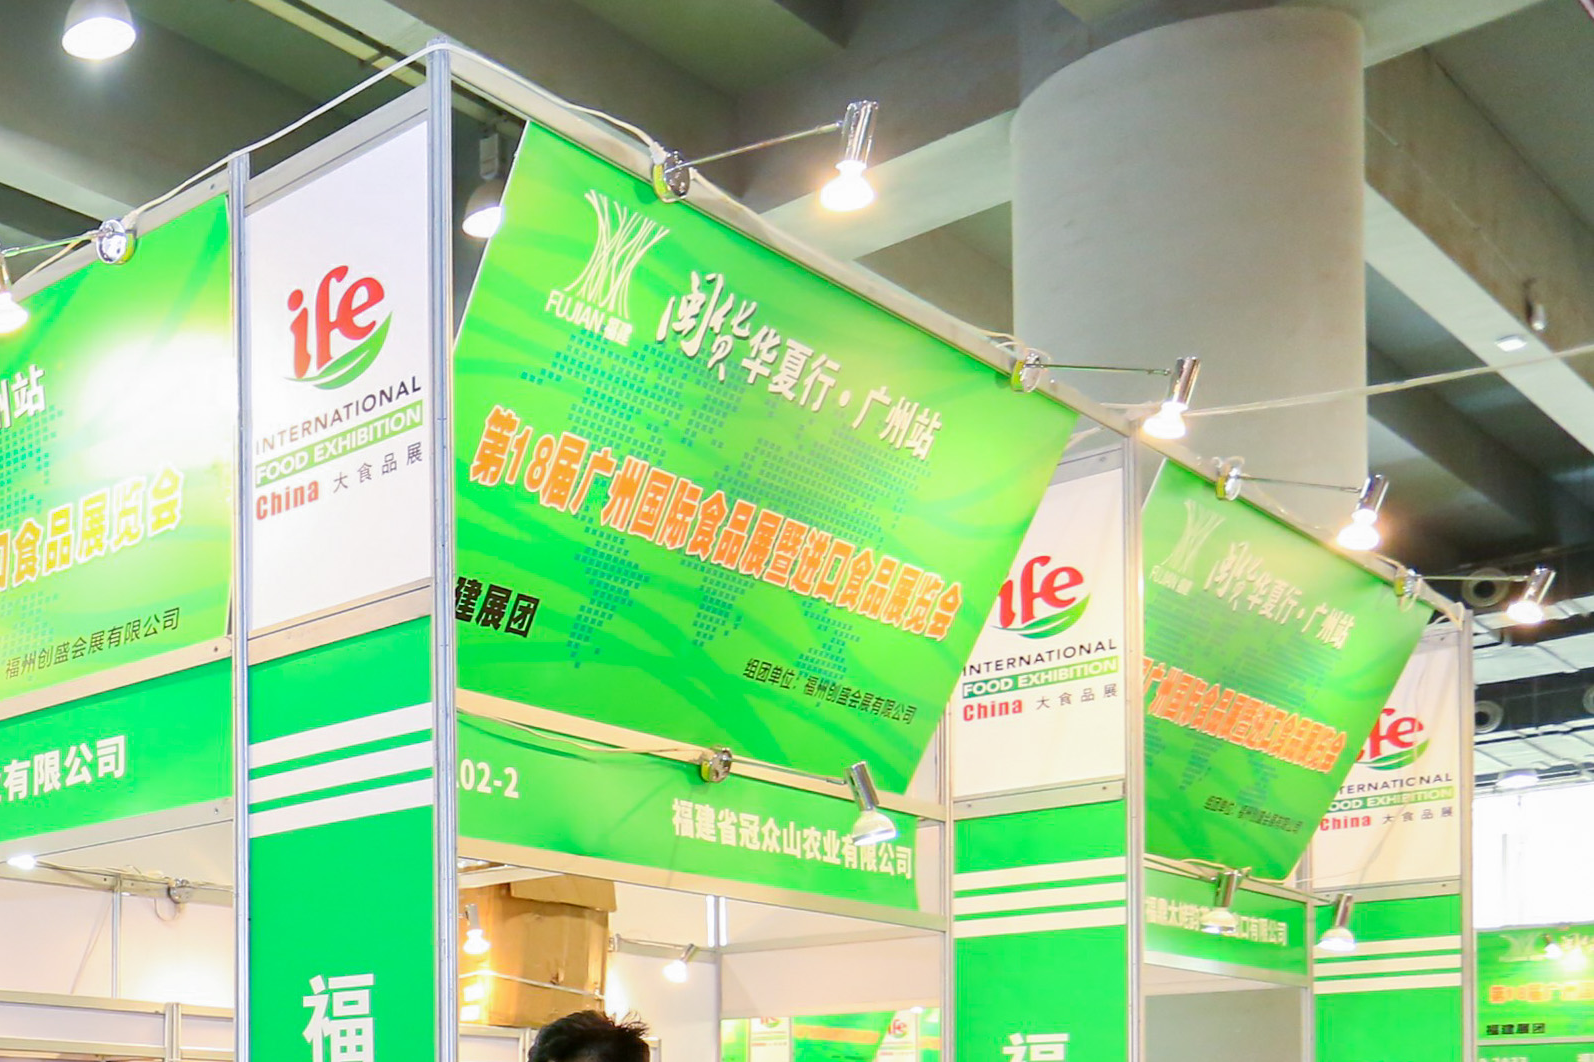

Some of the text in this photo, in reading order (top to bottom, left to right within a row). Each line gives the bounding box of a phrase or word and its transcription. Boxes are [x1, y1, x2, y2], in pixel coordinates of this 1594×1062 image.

[287, 265, 385, 379] ife
[545, 289, 606, 334] FUJIAN
[257, 375, 422, 456] INTERNATIONAL
[257, 406, 422, 485] FOOD EXHIBITION
[256, 441, 424, 521] China 大食品展
[963, 639, 1117, 677] INTERNATIONAL
[963, 660, 1118, 698] FOOD EXHIBITION
[963, 683, 1117, 722] China 大食品展
[1356, 708, 1424, 762] fe
[456, 758, 520, 800] 02-2
[1320, 815, 1371, 831] China
[1328, 799, 1363, 813] OOD
[671, 798, 913, 880] 福建省冠众山农业有限公司
